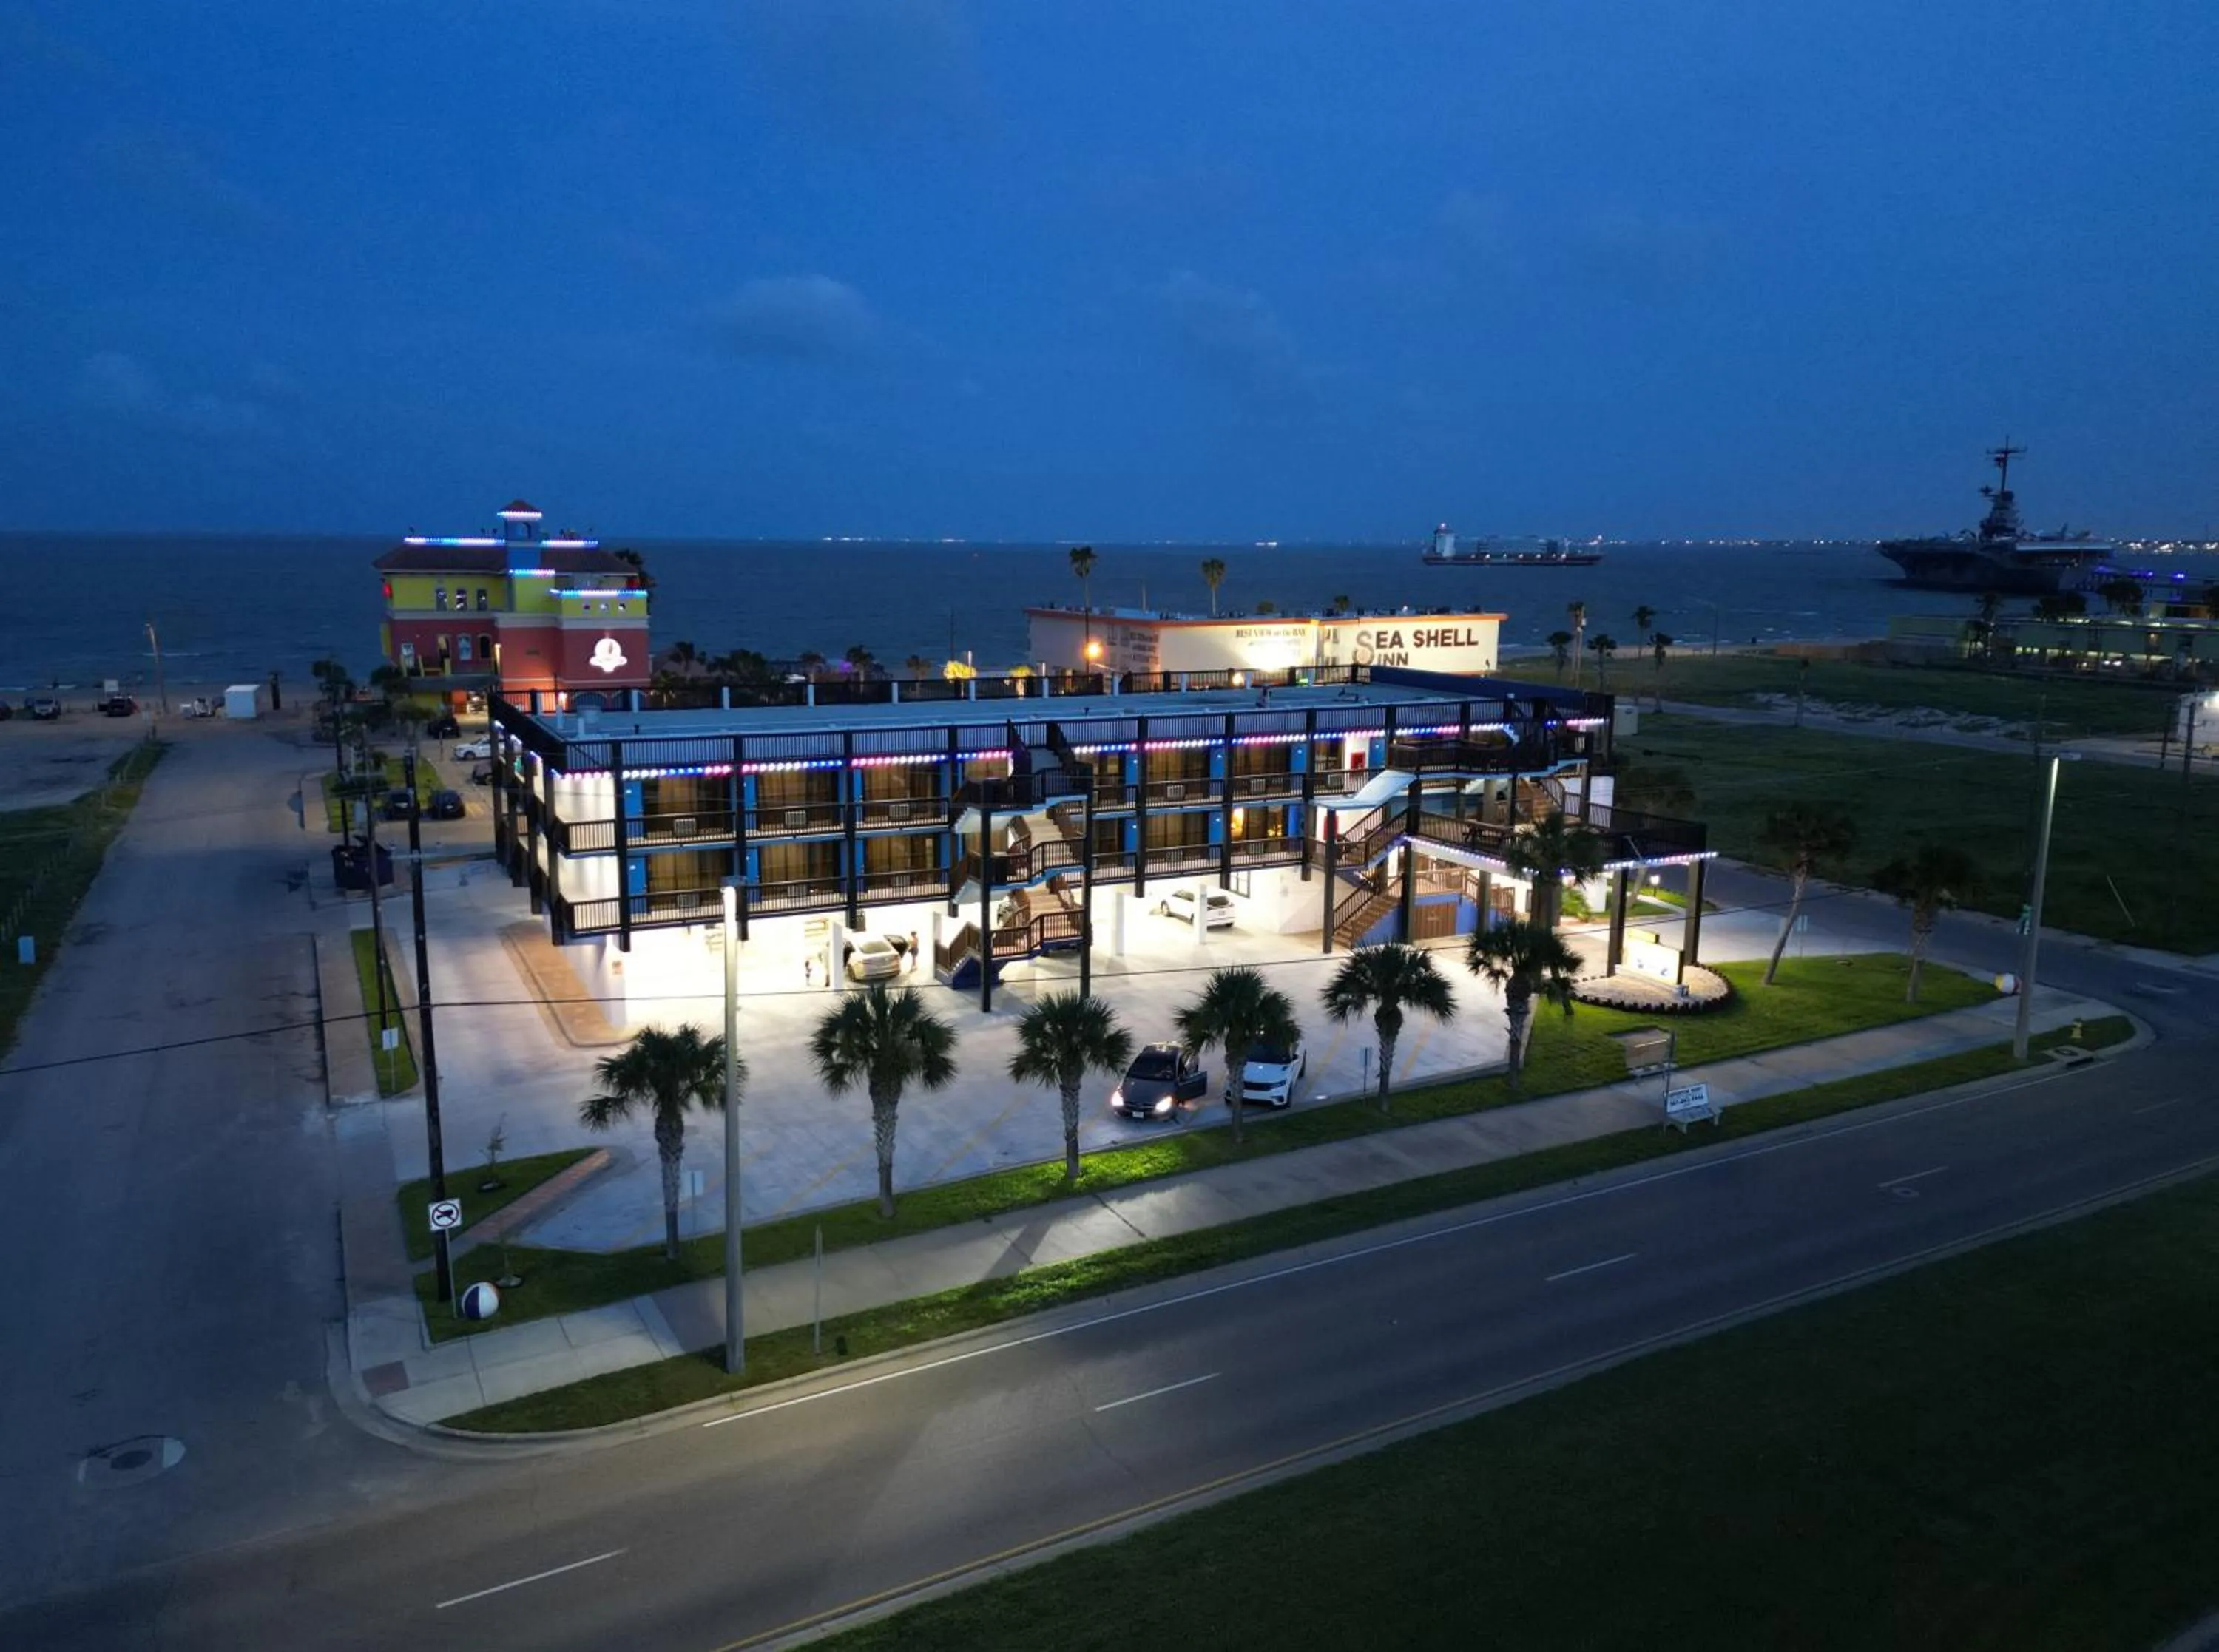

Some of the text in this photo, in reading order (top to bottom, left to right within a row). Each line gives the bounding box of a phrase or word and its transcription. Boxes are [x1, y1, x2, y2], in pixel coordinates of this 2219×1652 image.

[1353, 630, 1404, 666] SEA
[1413, 628, 1479, 649] SHELL
[1377, 651, 1409, 666] INN
